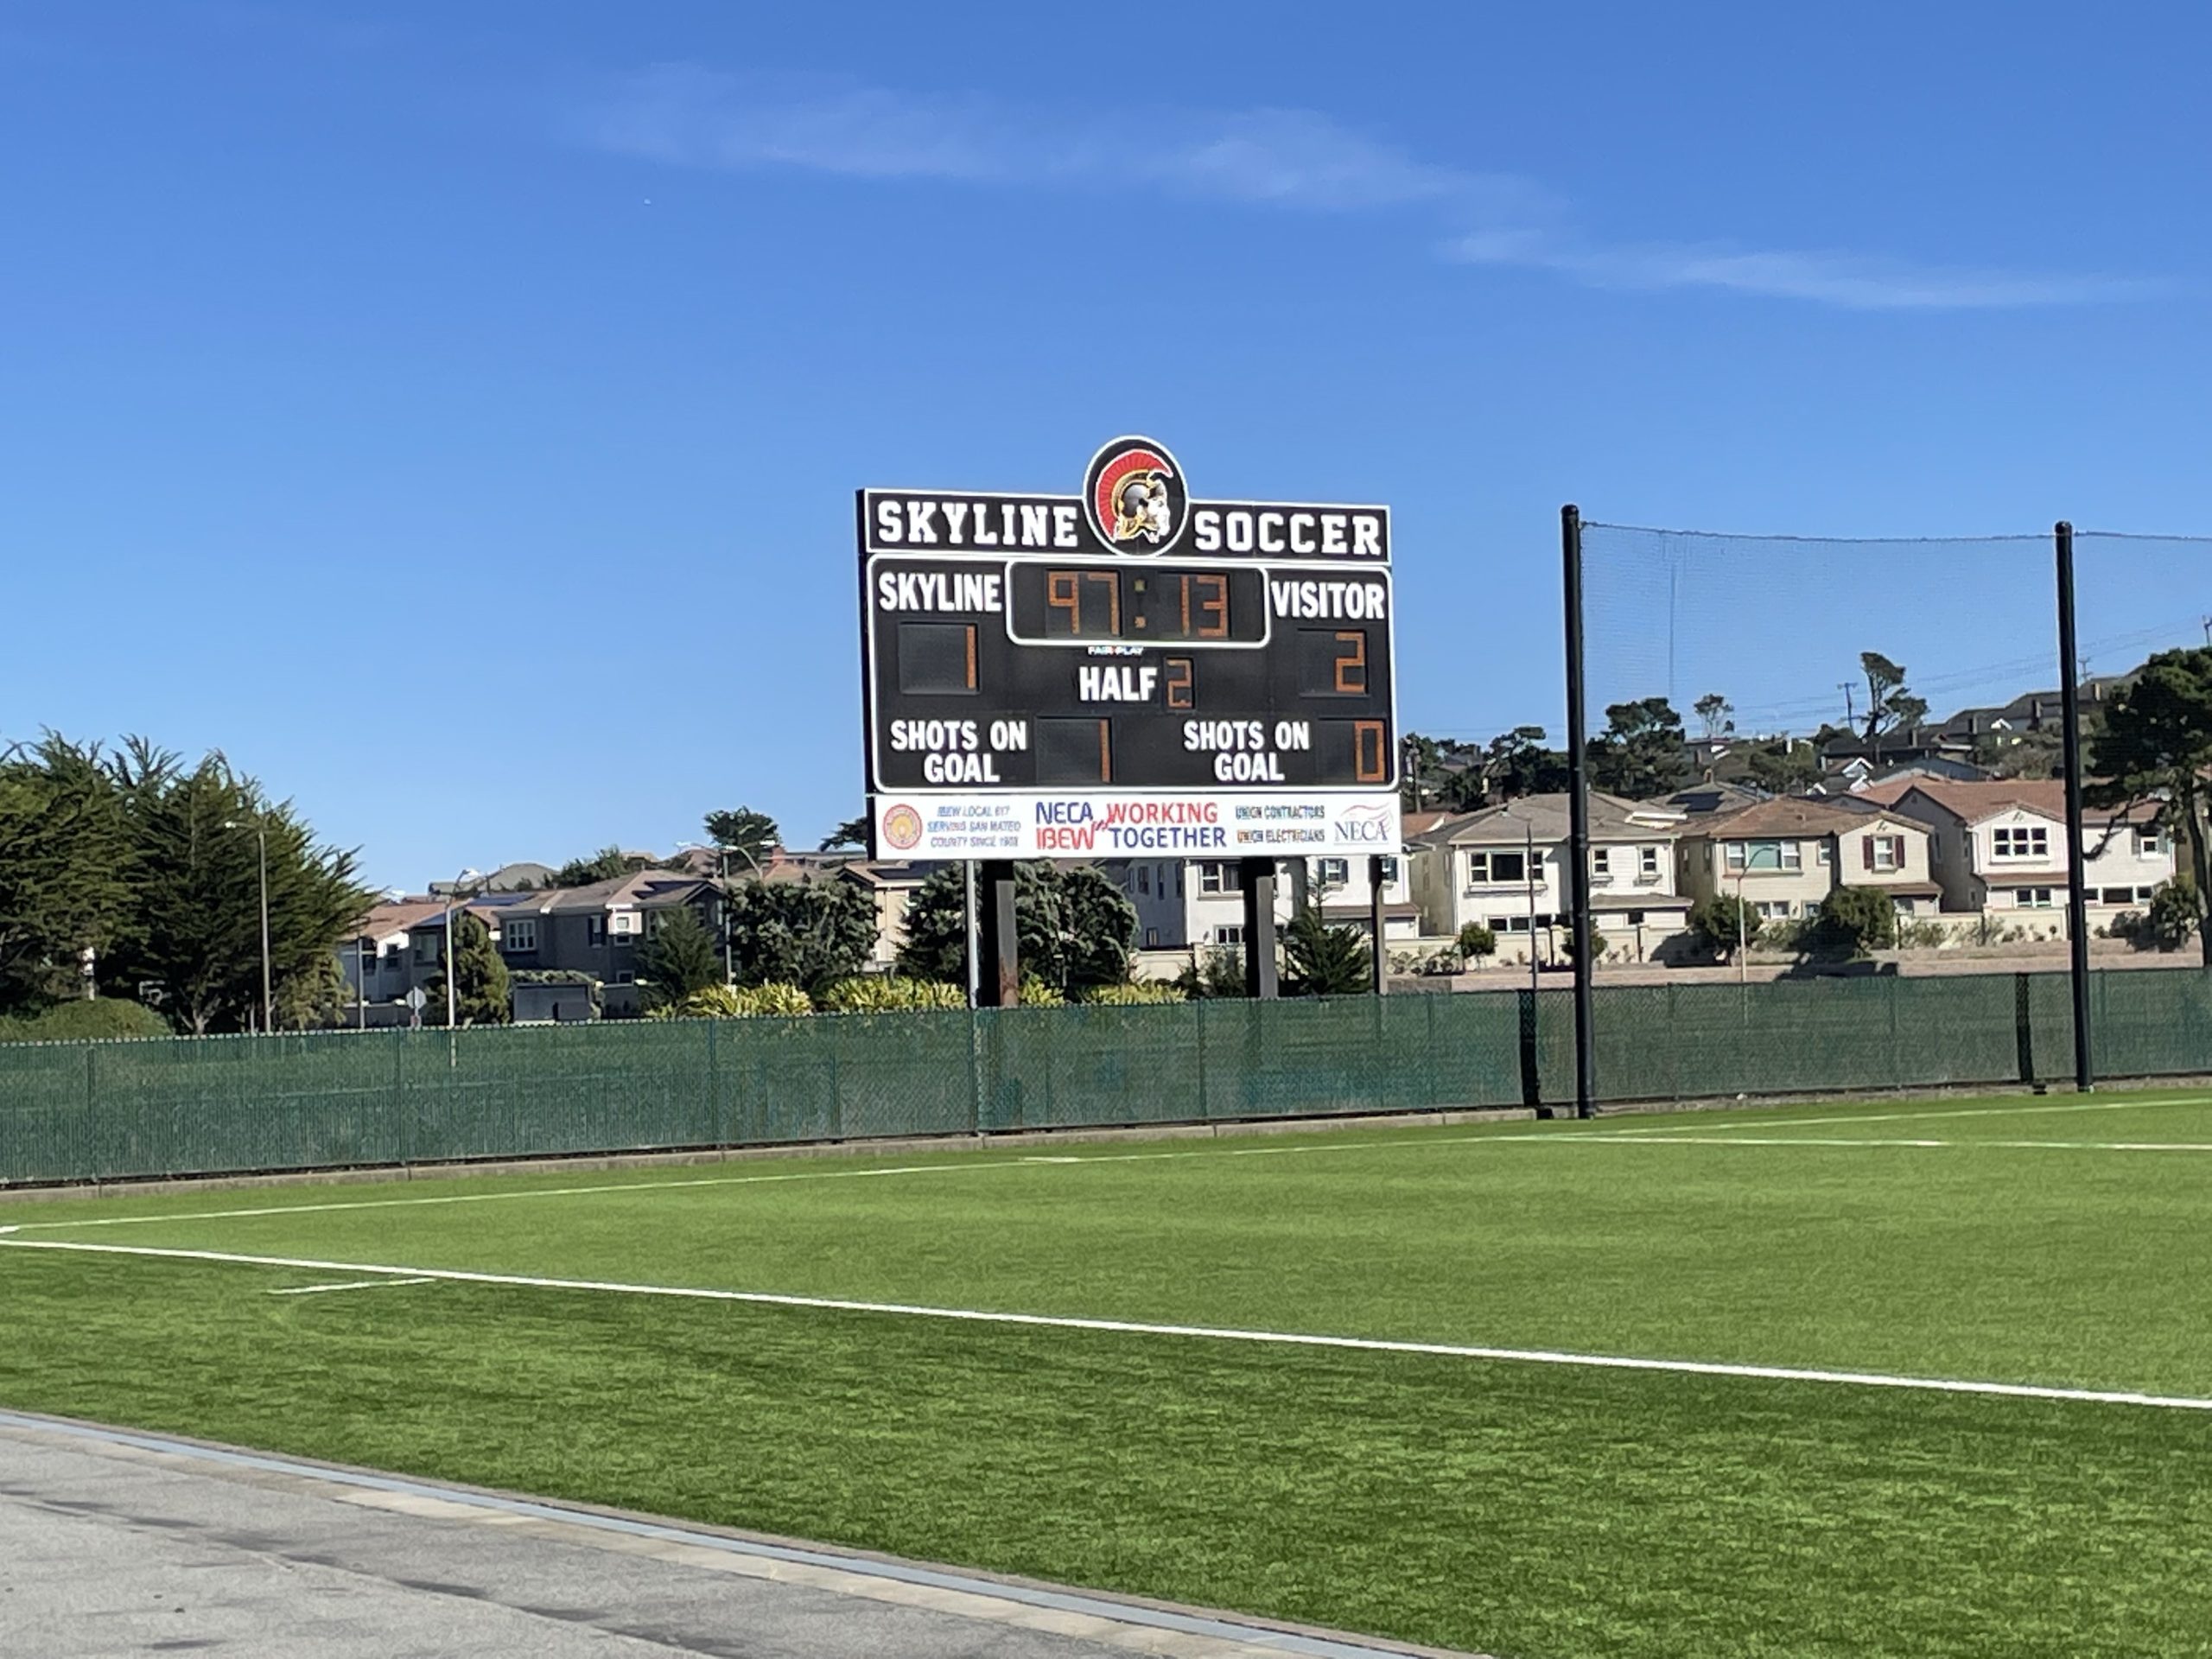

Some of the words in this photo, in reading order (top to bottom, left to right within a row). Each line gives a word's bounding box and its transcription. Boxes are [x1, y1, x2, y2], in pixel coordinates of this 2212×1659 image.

[878, 501, 1078, 547] SKYLINE
[1194, 512, 1381, 556] SOCCER
[879, 572, 1001, 612] SKYLINE
[1271, 582, 1384, 619] VISITOR
[967, 626, 976, 689] 1
[1336, 632, 1366, 692] 2
[1079, 666, 1158, 702] HALF
[1167, 659, 1192, 709] 2
[890, 720, 978, 751] SHOTS
[989, 720, 1027, 751] ON
[1183, 721, 1265, 751] SHOTS
[1274, 721, 1310, 750] ON
[1099, 719, 1111, 783] 1
[1354, 720, 1385, 782] 0
[924, 753, 1001, 783] GOAL
[1214, 753, 1286, 782] GOAL
[969, 821, 988, 833] SAN
[989, 821, 1021, 832] MATEO
[1036, 801, 1094, 824] NECA
[1107, 802, 1218, 824] WORKING
[931, 836, 968, 848] COUNTY
[969, 836, 996, 847] SINCE
[1036, 827, 1096, 849] IBEW
[1108, 826, 1227, 849] TOGETHER
[1334, 821, 1389, 842] NECA
